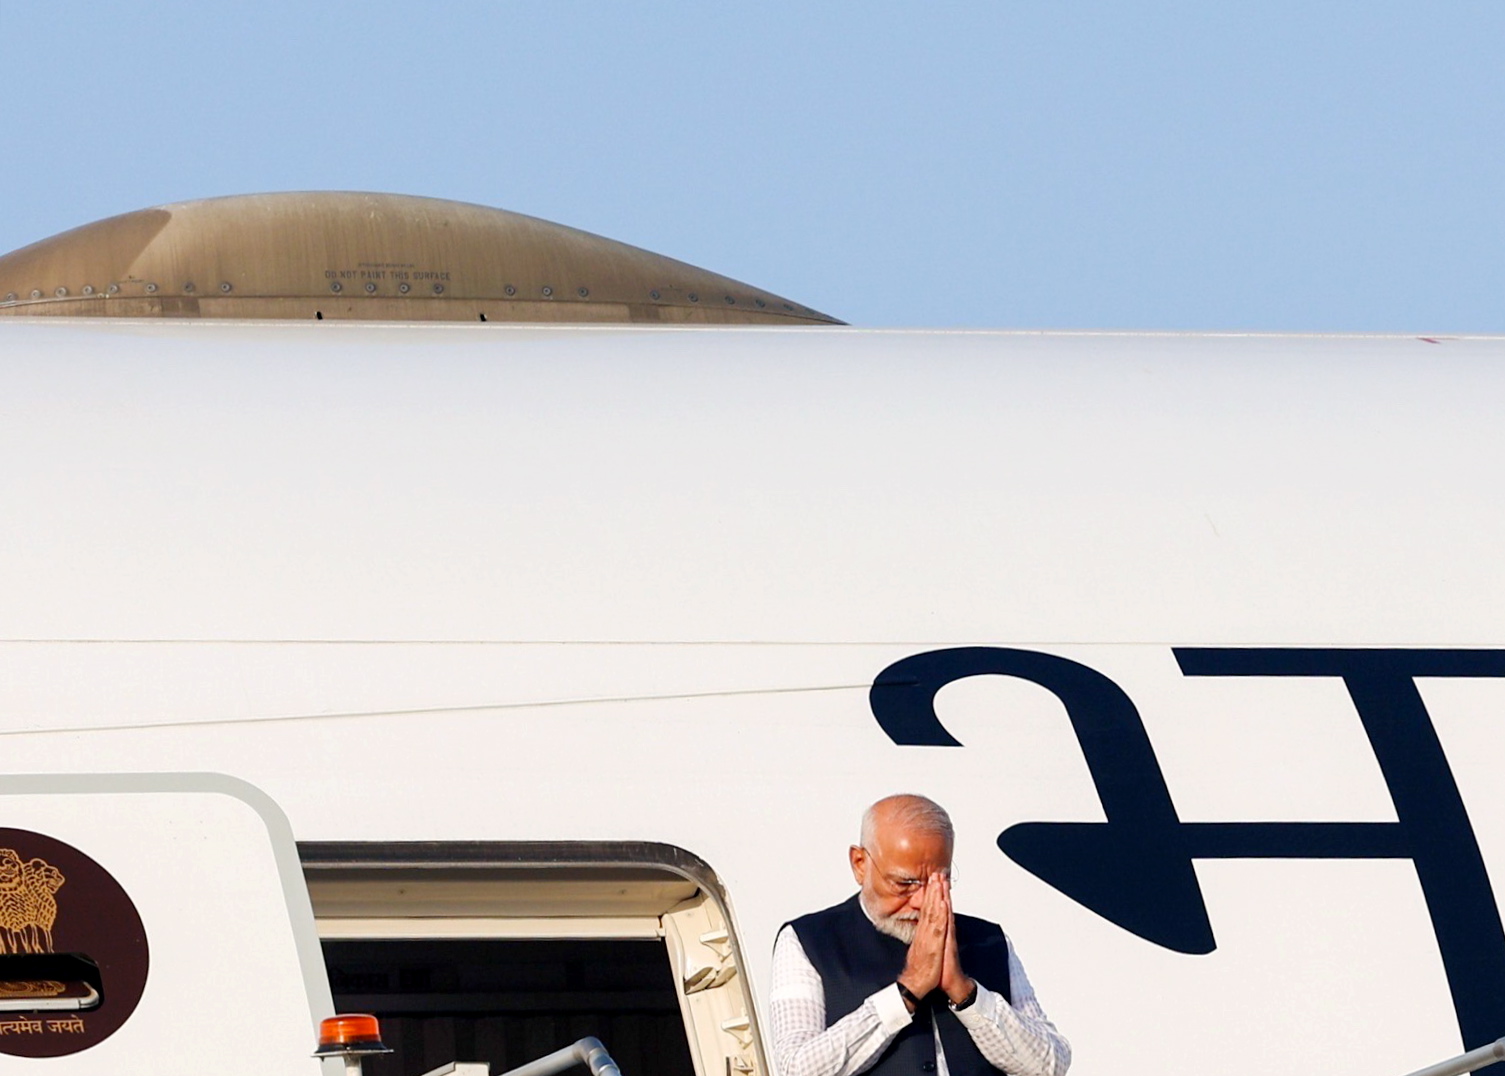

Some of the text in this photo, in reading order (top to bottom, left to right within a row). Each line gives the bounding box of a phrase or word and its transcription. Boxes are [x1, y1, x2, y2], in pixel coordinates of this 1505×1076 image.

[340, 270, 357, 279] NOT
[360, 270, 386, 279] PAINT
[390, 271, 410, 280] THIS
[413, 271, 450, 281] SURFACE
[46, 1013, 85, 1034] जयते
